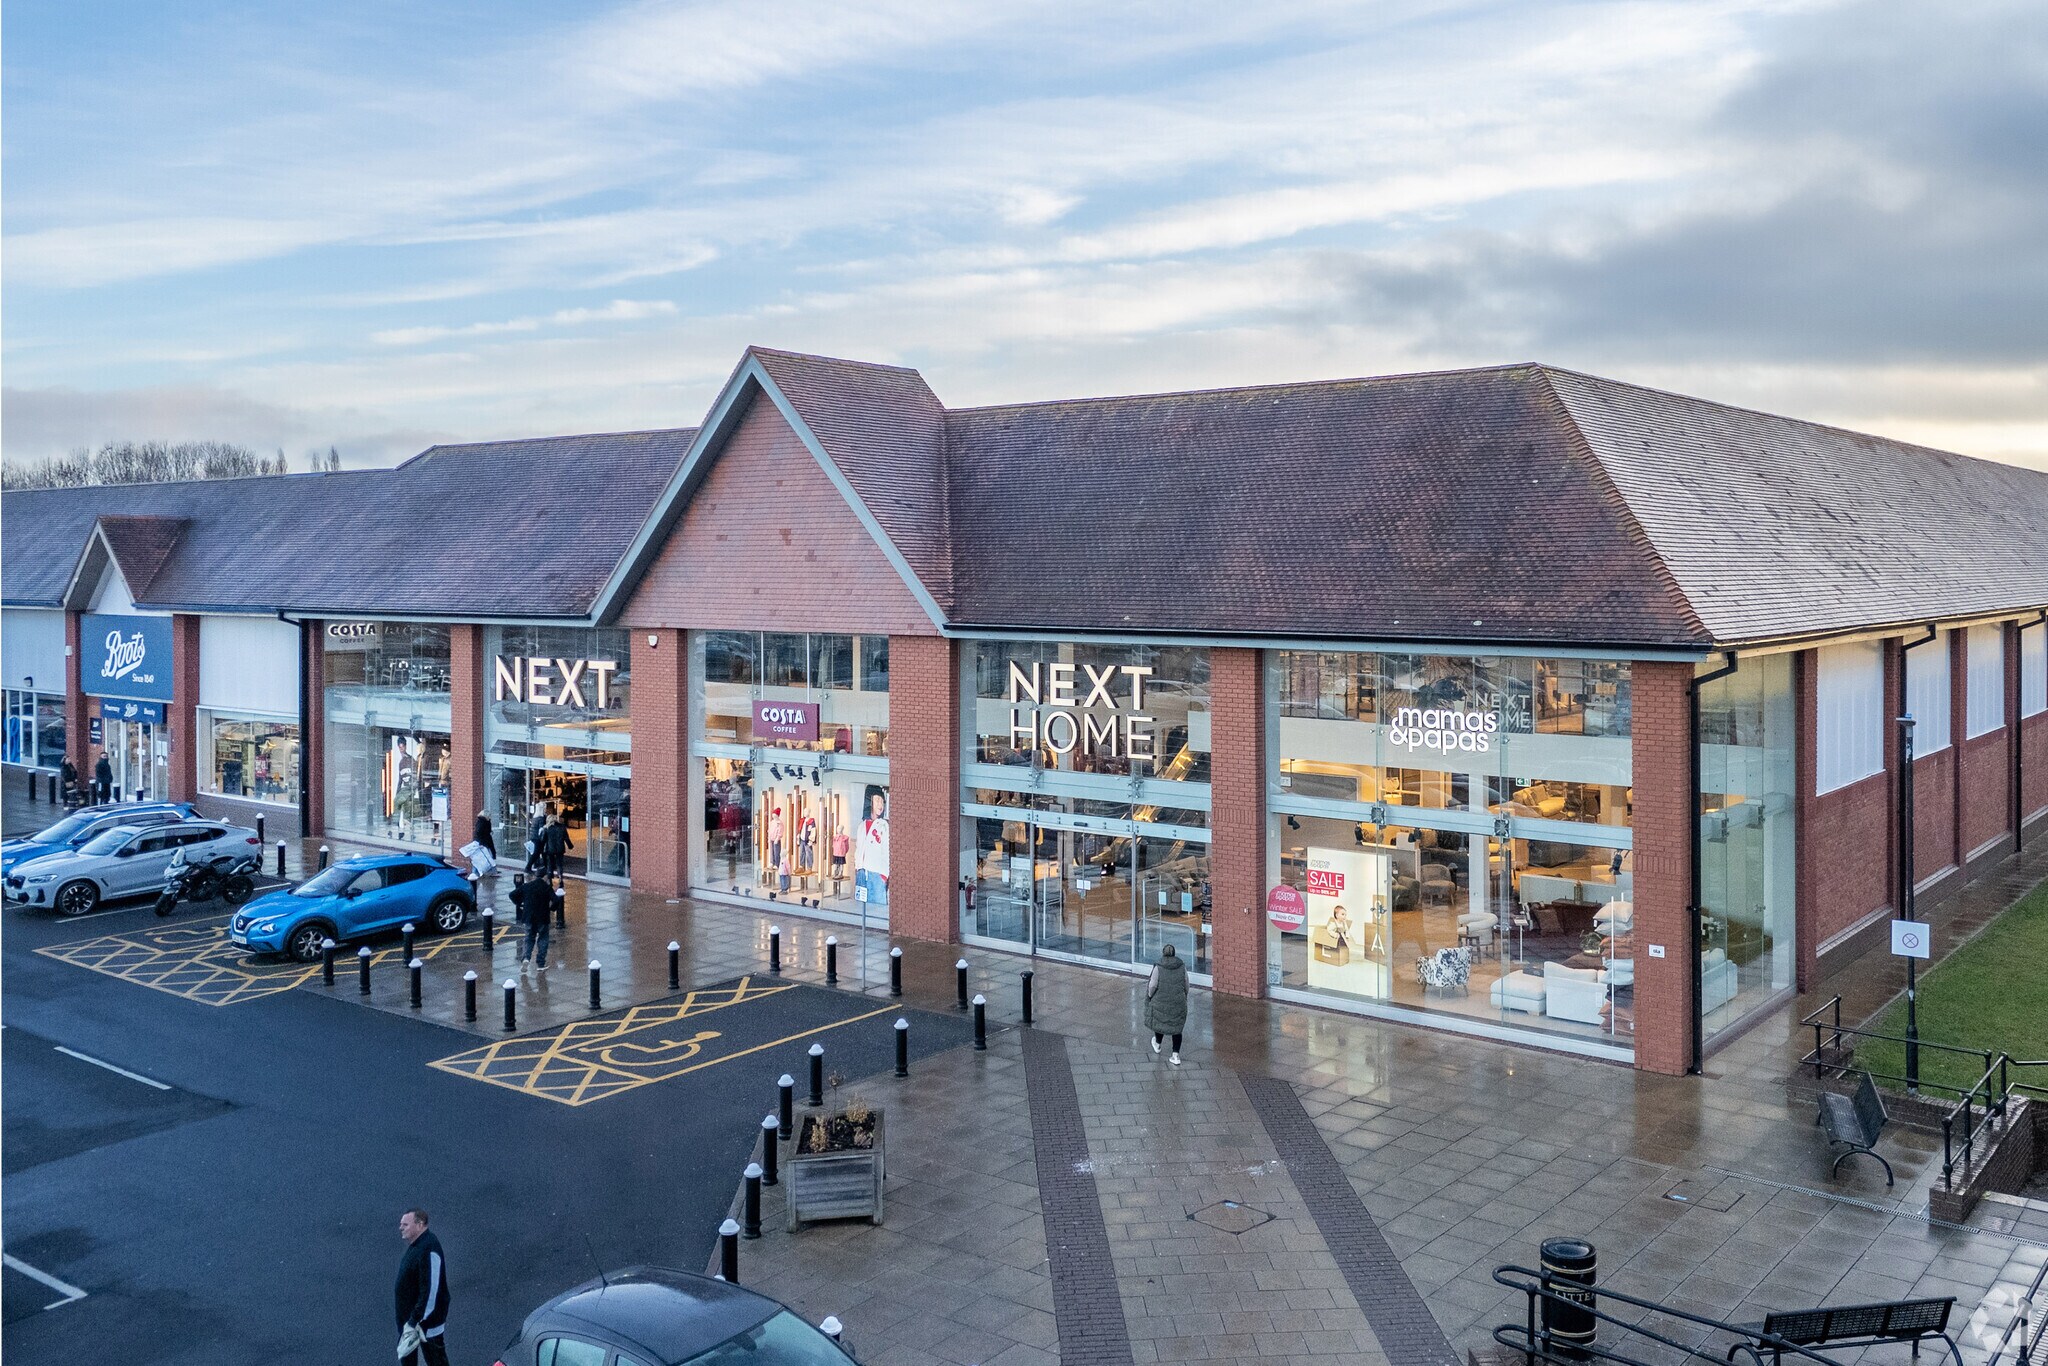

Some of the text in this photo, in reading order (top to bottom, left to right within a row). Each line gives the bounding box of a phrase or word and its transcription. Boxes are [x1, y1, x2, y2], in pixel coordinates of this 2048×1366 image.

[328, 623, 377, 637] COSTA
[101, 630, 145, 680] Boots
[495, 654, 617, 709] NEXT
[1009, 660, 1153, 711] NEXT
[1475, 692, 1530, 709] NEXT
[761, 707, 807, 725] COSTA
[1398, 707, 1497, 733] mamas
[1010, 709, 1153, 760] HOME
[1389, 716, 1490, 756] &papas
[1310, 871, 1343, 889] SALE
[1290, 906, 1303, 914] SALE
